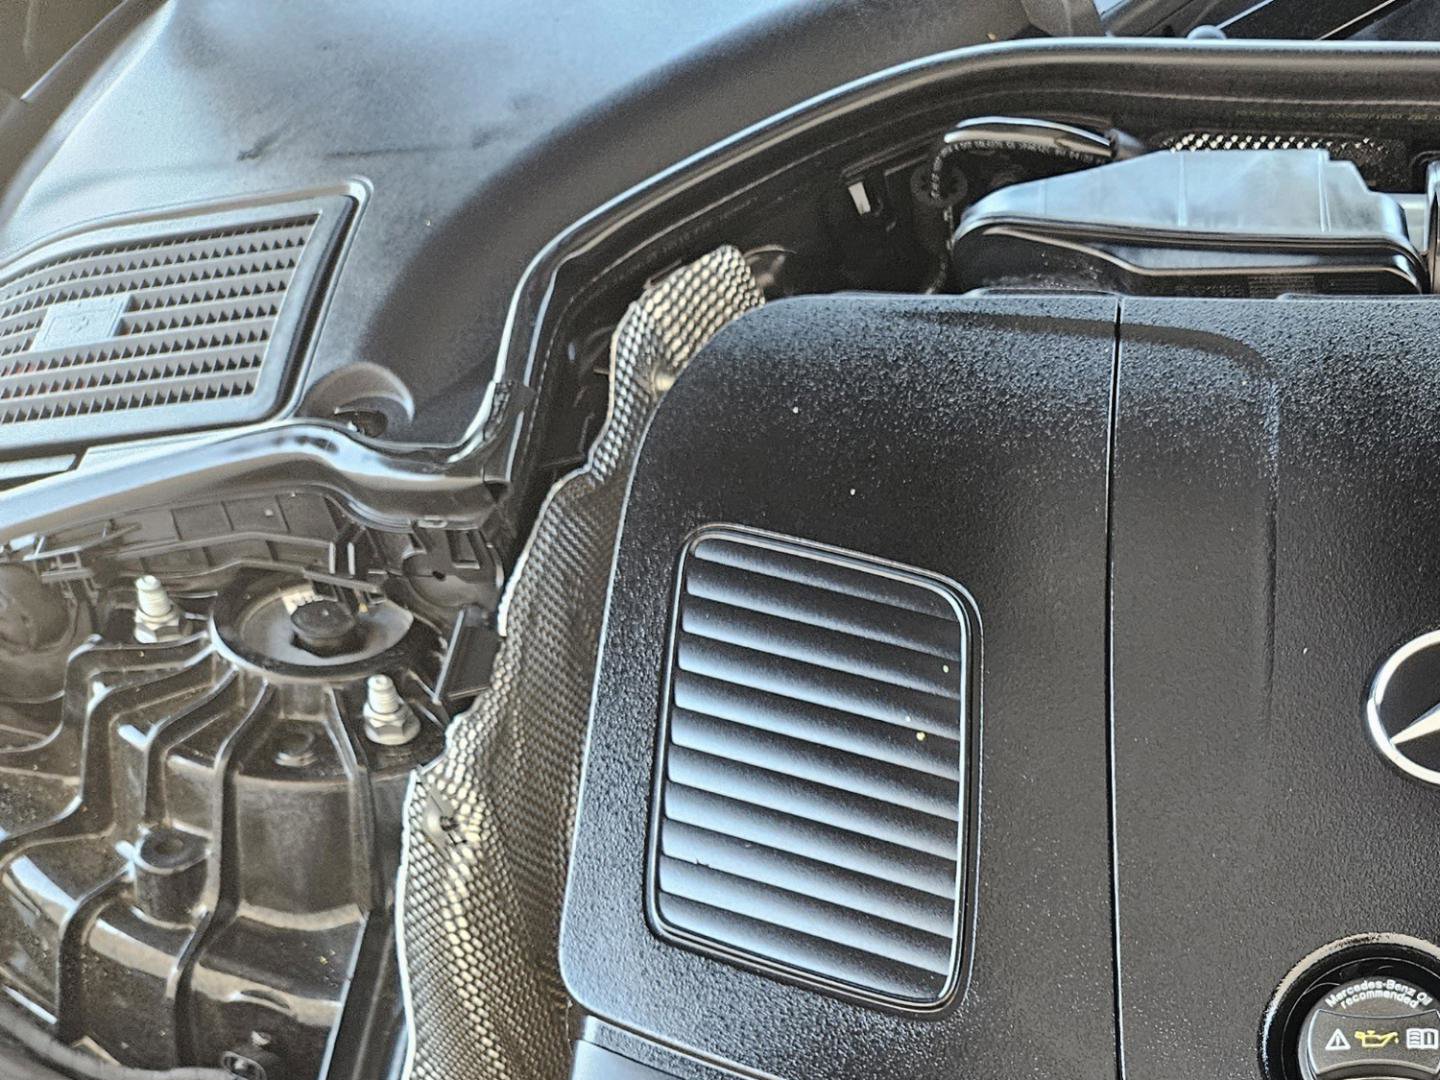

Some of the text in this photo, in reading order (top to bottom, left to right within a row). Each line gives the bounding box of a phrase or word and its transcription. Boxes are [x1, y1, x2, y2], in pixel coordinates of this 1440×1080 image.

[1325, 979, 1432, 1007] Mercedes-Benz Oil
[1341, 990, 1419, 1008] recommended
